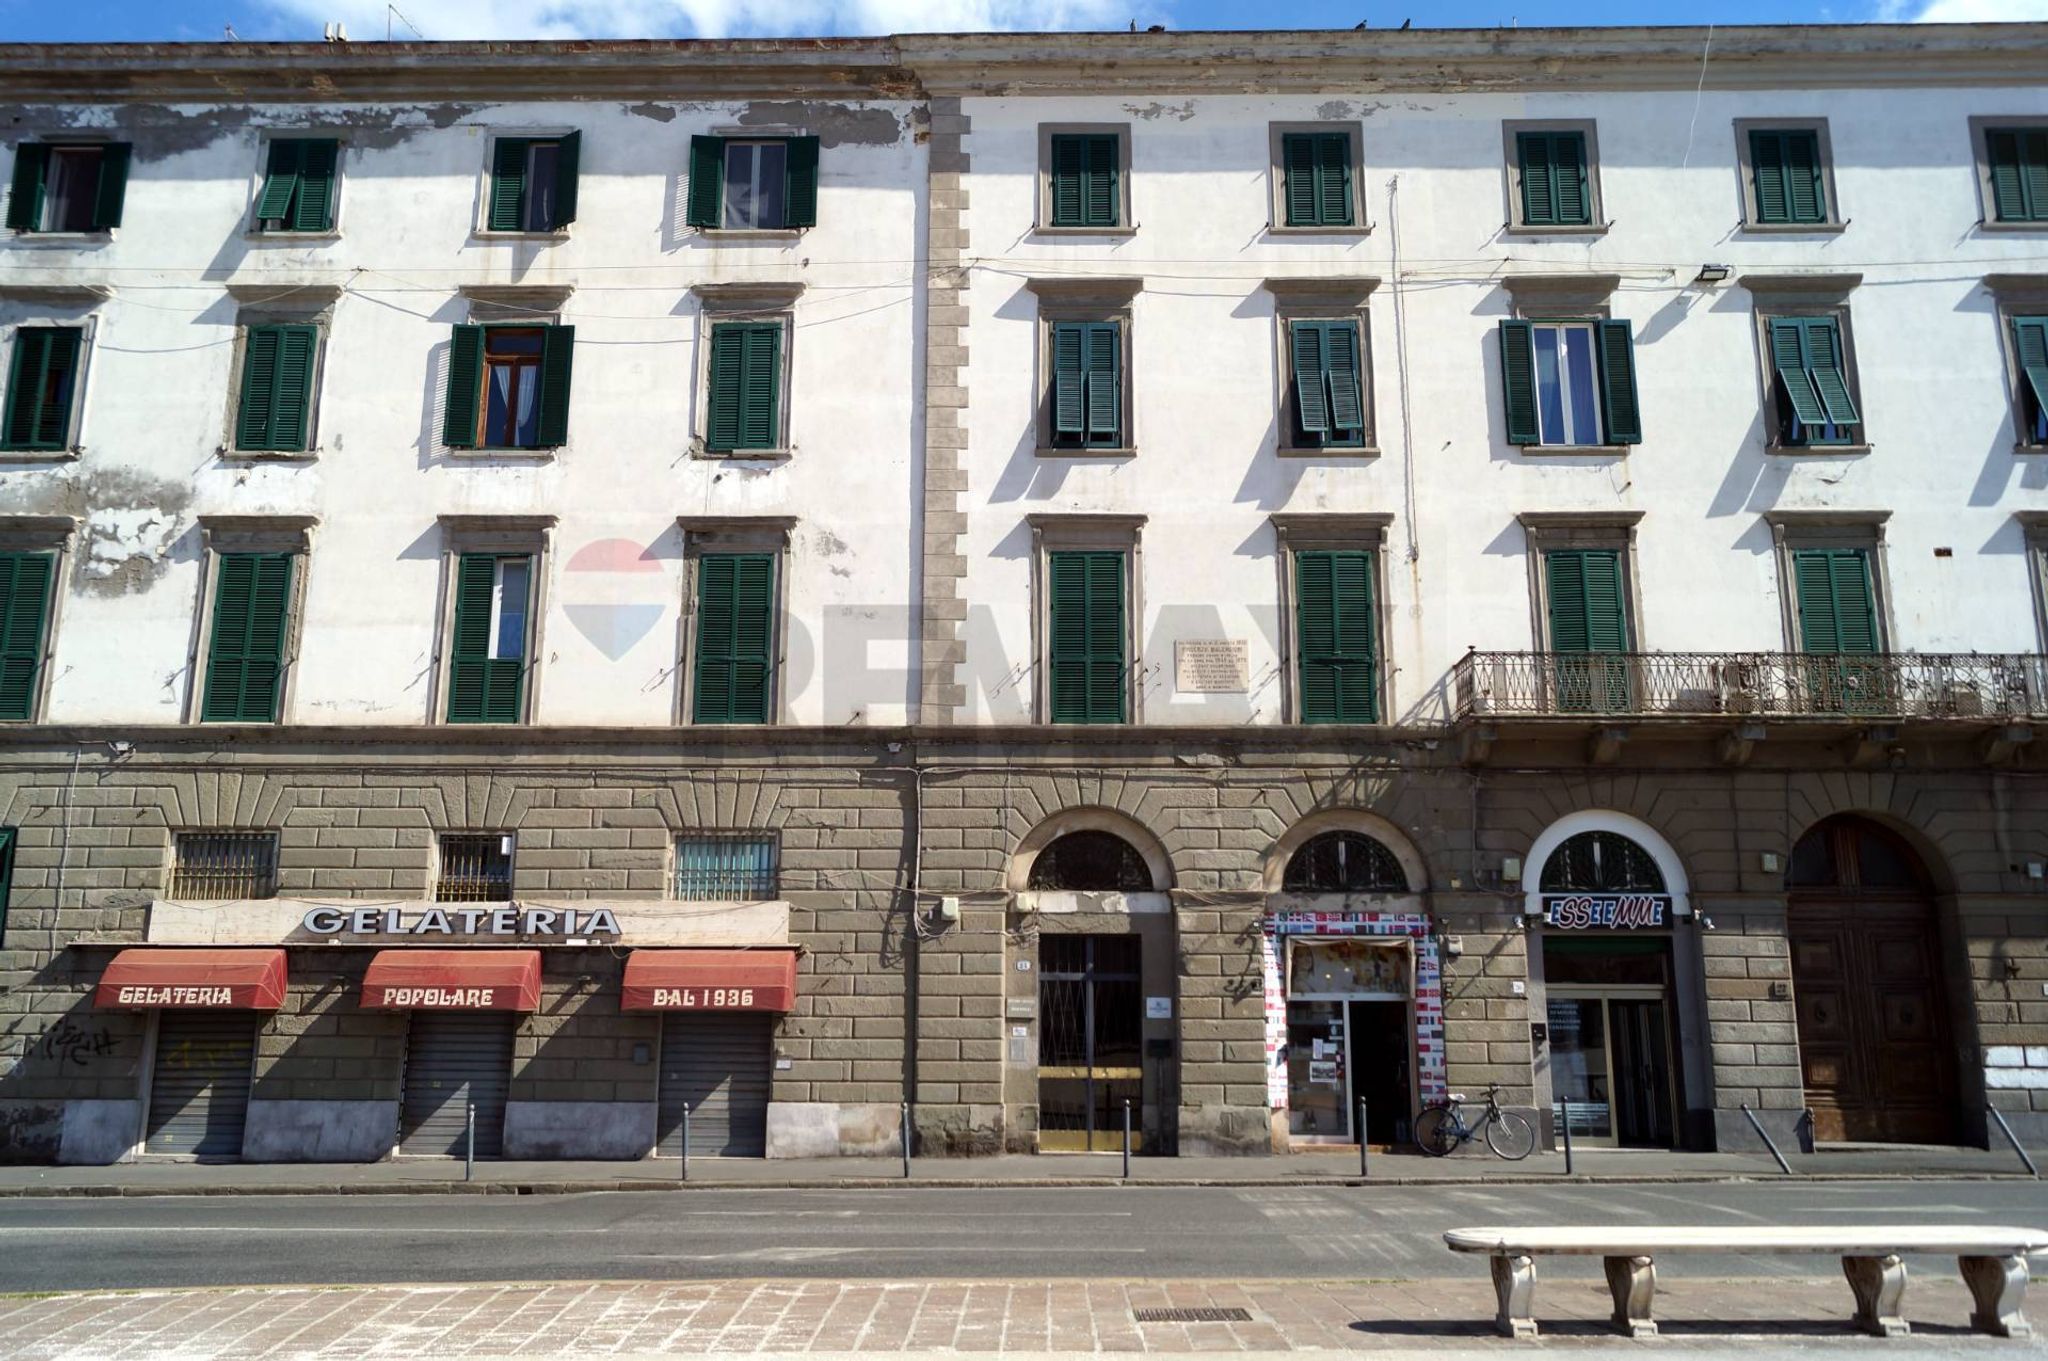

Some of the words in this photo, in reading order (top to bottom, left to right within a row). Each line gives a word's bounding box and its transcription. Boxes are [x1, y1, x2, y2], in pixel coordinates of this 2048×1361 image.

[302, 907, 622, 935] GELATERIA
[118, 987, 232, 1006] GELATERIA
[383, 988, 494, 1008] POPOLARE
[653, 989, 695, 1006] DAL
[703, 989, 754, 1006] 1936
